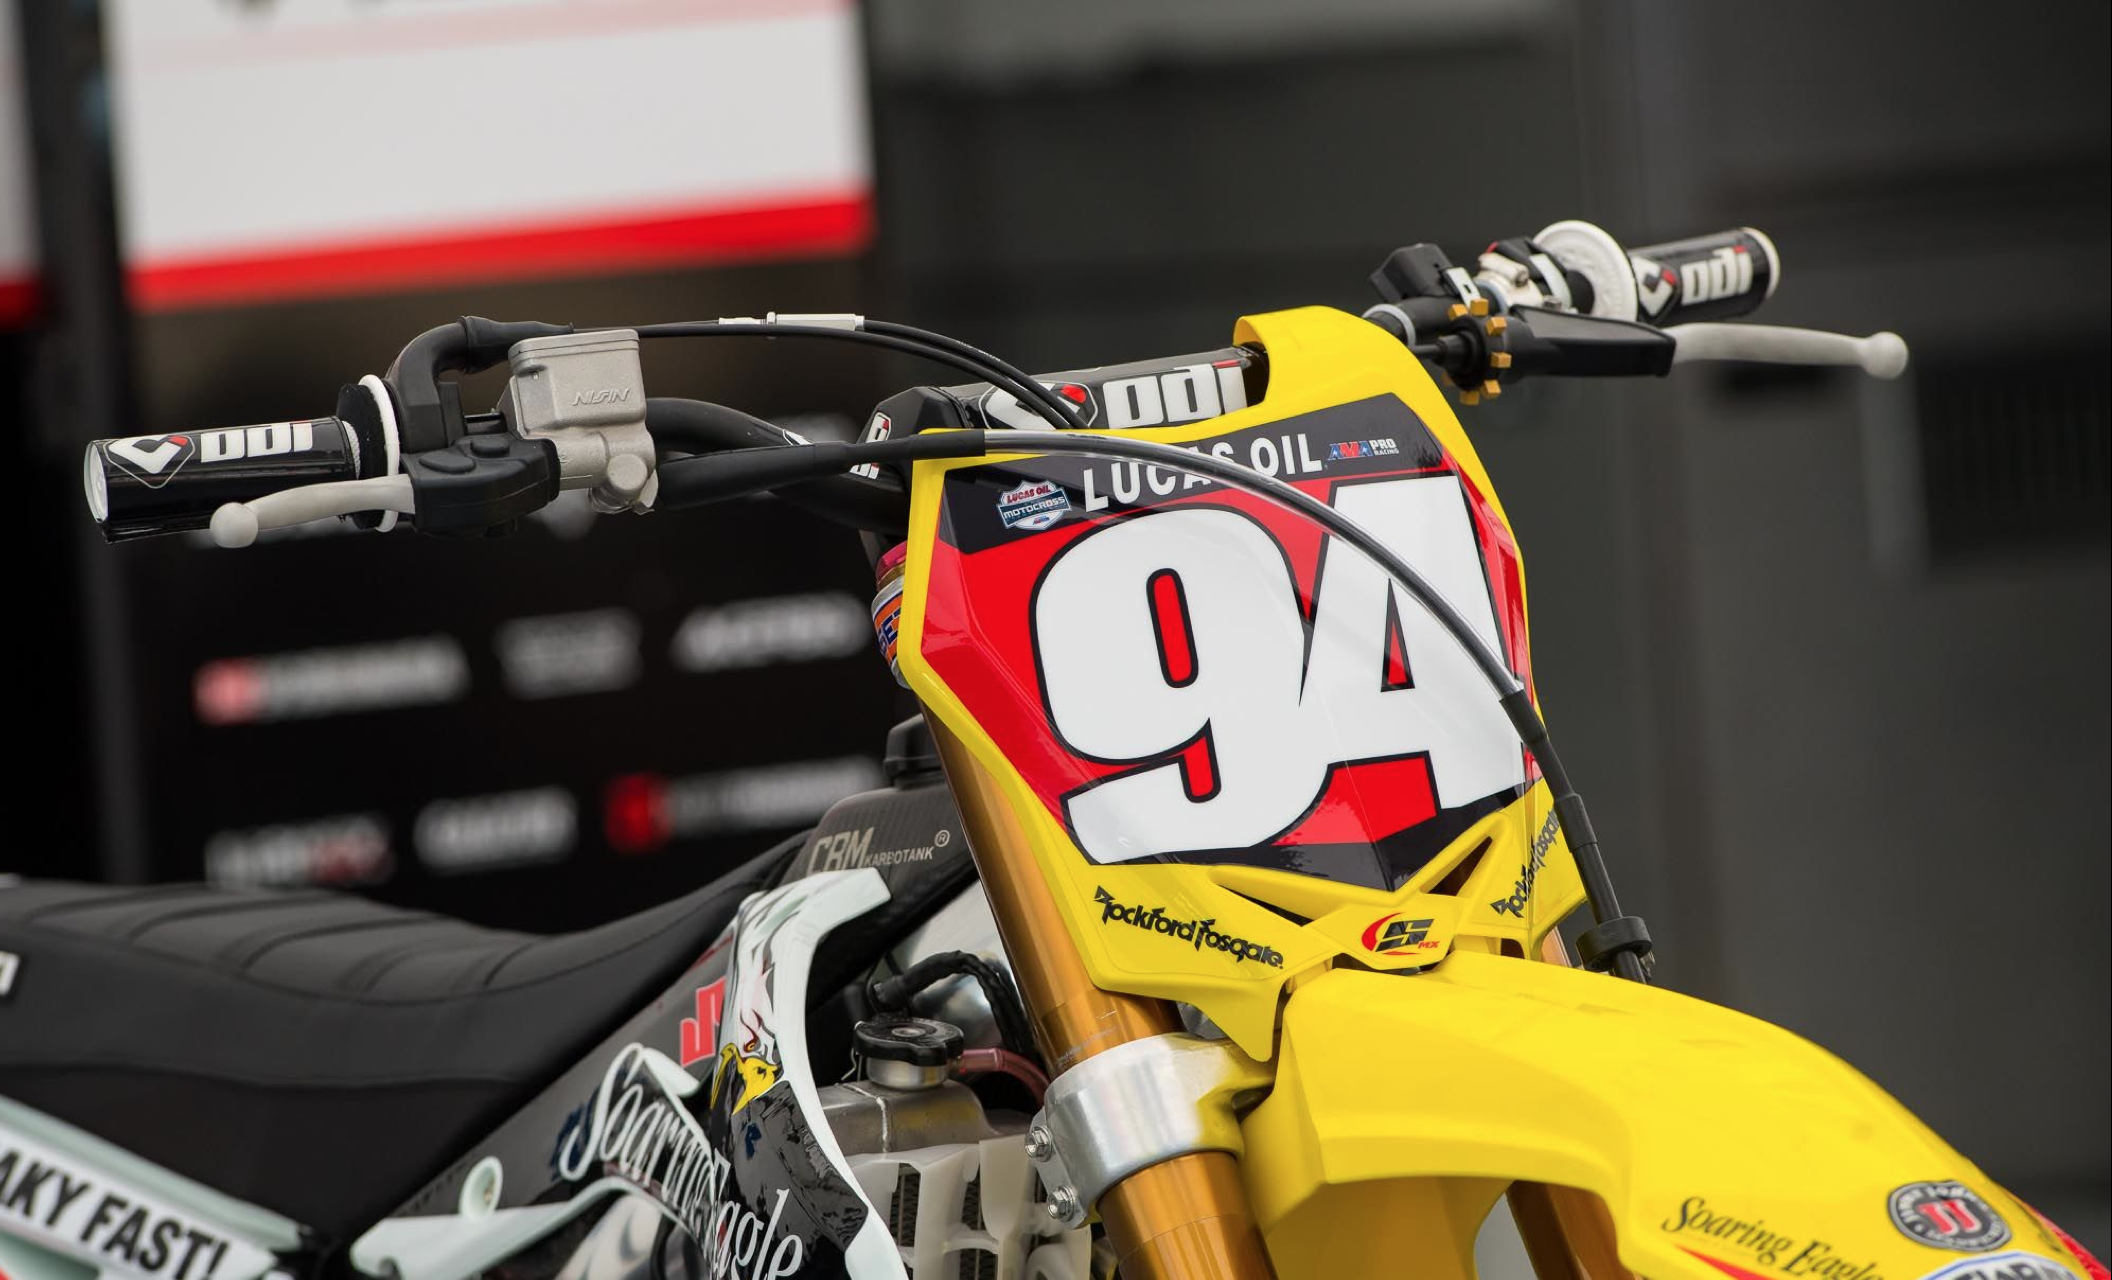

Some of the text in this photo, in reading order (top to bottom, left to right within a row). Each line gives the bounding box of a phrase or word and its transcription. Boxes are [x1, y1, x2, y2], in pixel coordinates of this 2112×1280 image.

[1250, 433, 1323, 478] OIL
[1327, 438, 1397, 460] AMA PRO
[1003, 496, 1066, 519] MOTOCROSS
[1007, 485, 1051, 503] LUCAS OIL
[1031, 474, 1527, 865] 94
[1093, 885, 1197, 942] Rockford
[80, 1192, 230, 1280] FAST!
[1660, 1196, 1794, 1266] Soaring
